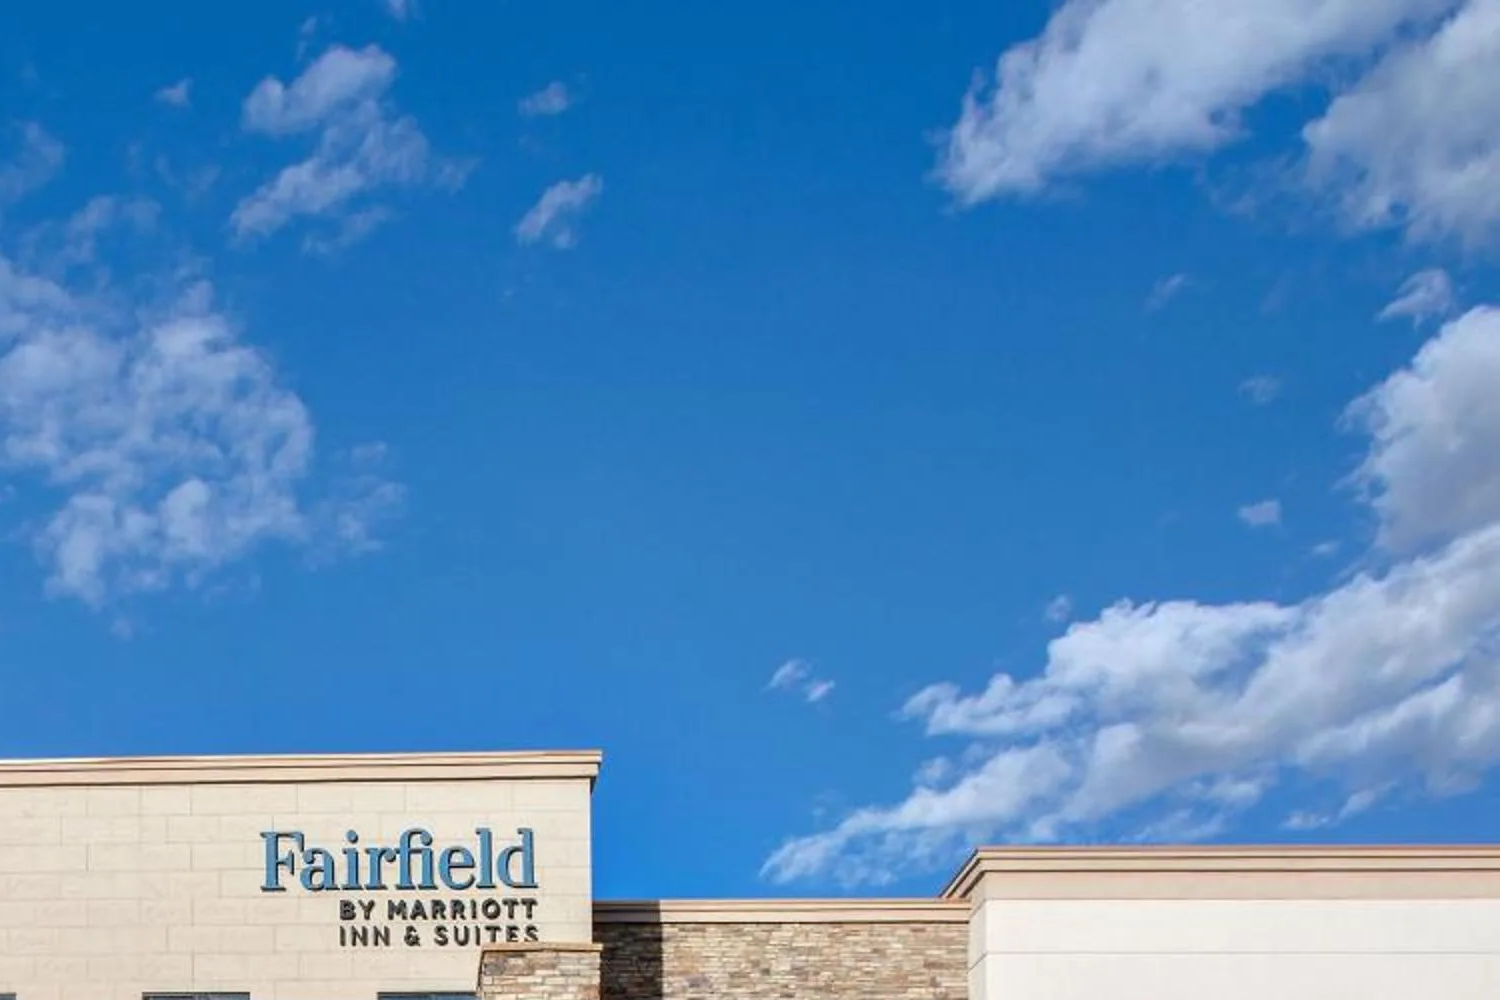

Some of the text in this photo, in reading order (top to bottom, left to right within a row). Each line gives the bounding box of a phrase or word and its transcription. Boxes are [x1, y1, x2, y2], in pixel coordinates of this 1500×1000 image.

[260, 827, 538, 891] Fairfield
[339, 898, 538, 920] BY MARRIOTT
[339, 925, 539, 946] INN & SUITES
